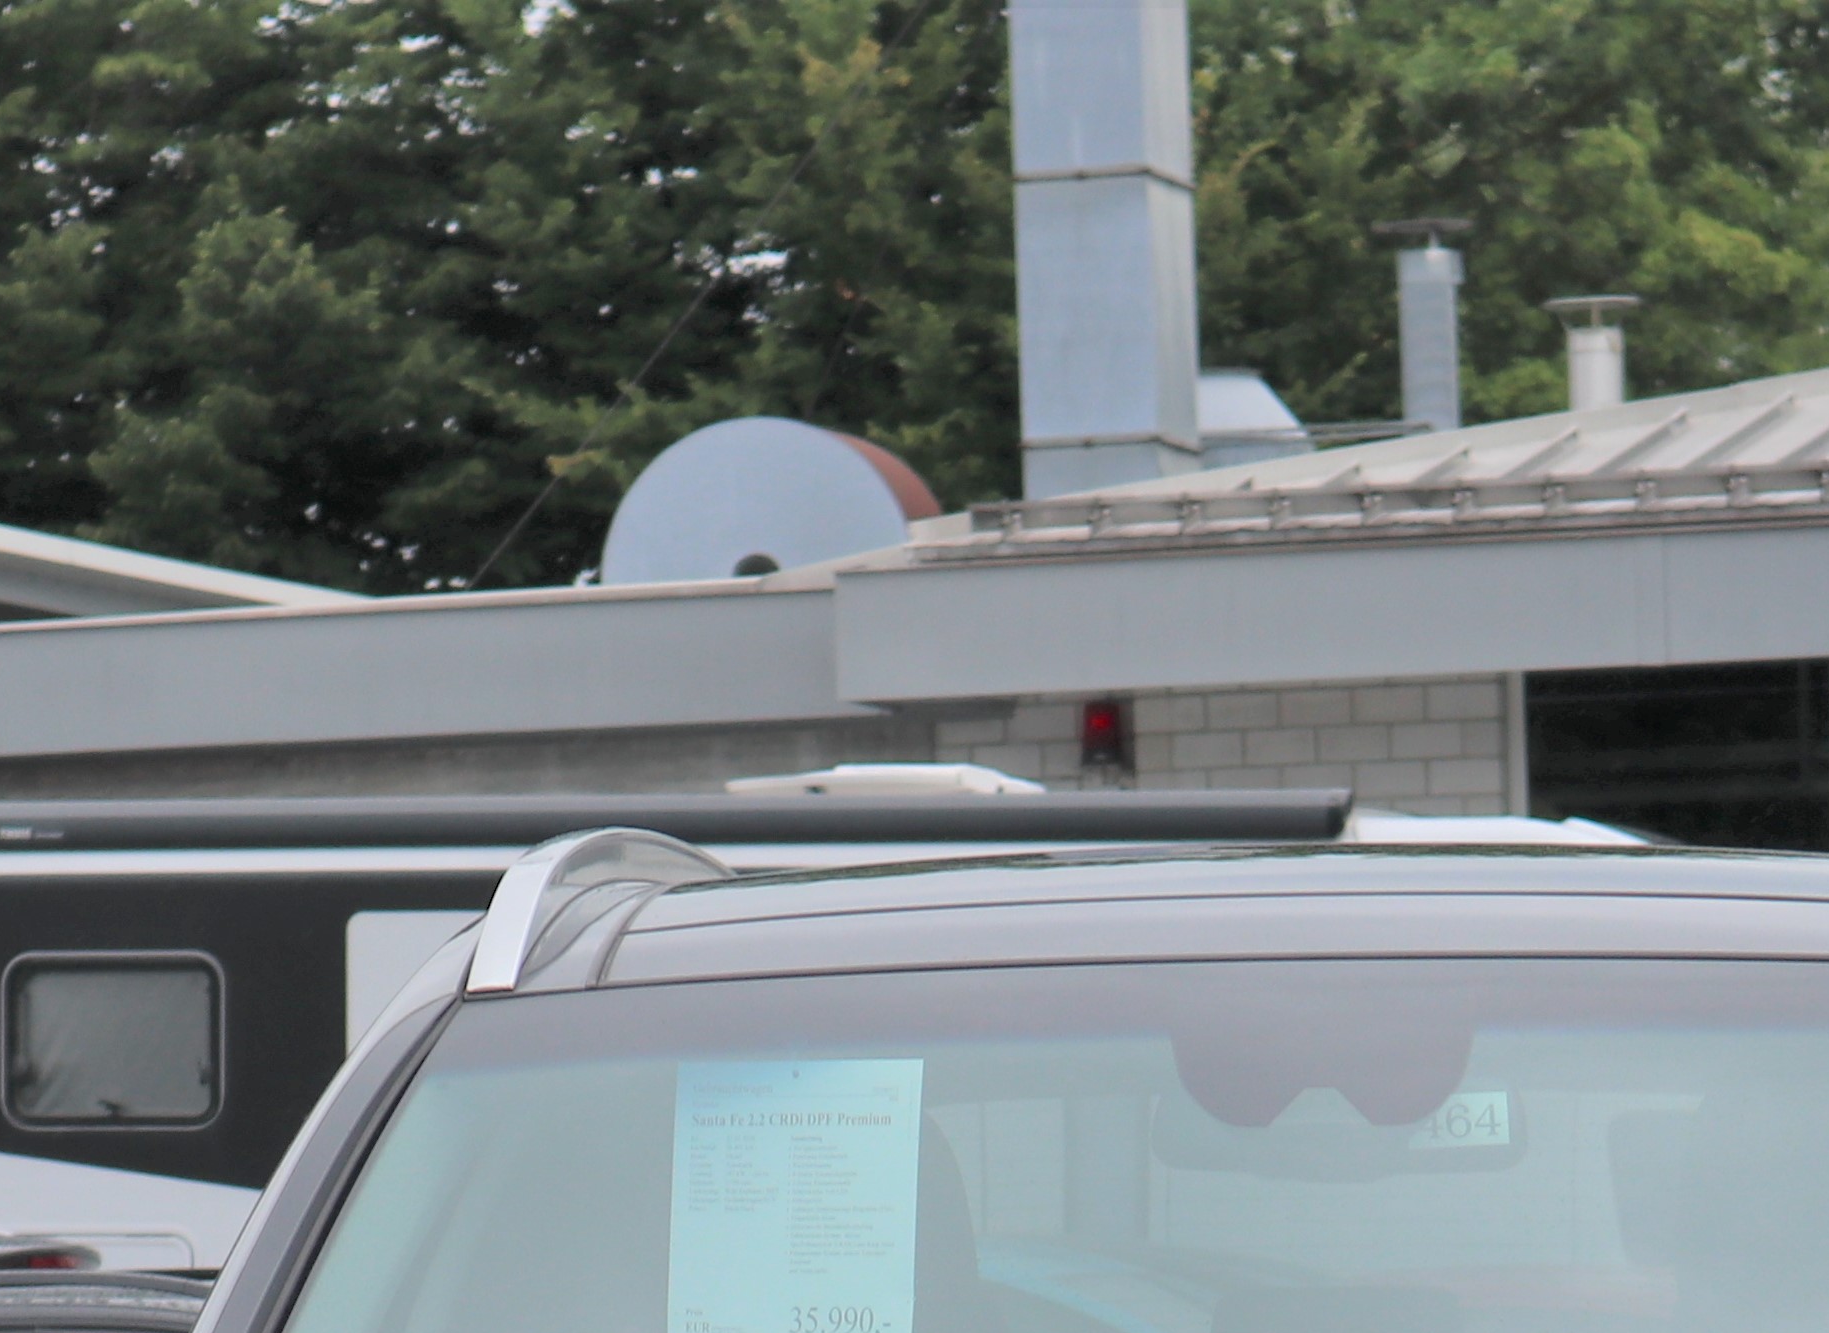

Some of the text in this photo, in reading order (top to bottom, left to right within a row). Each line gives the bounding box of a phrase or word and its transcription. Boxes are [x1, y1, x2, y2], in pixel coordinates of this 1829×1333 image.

[692, 1113, 726, 1127] Santa
[730, 1113, 745, 1127] Fe
[748, 1112, 766, 1127] 2.2
[807, 1112, 832, 1127] DPF
[837, 1112, 892, 1127] Premium
